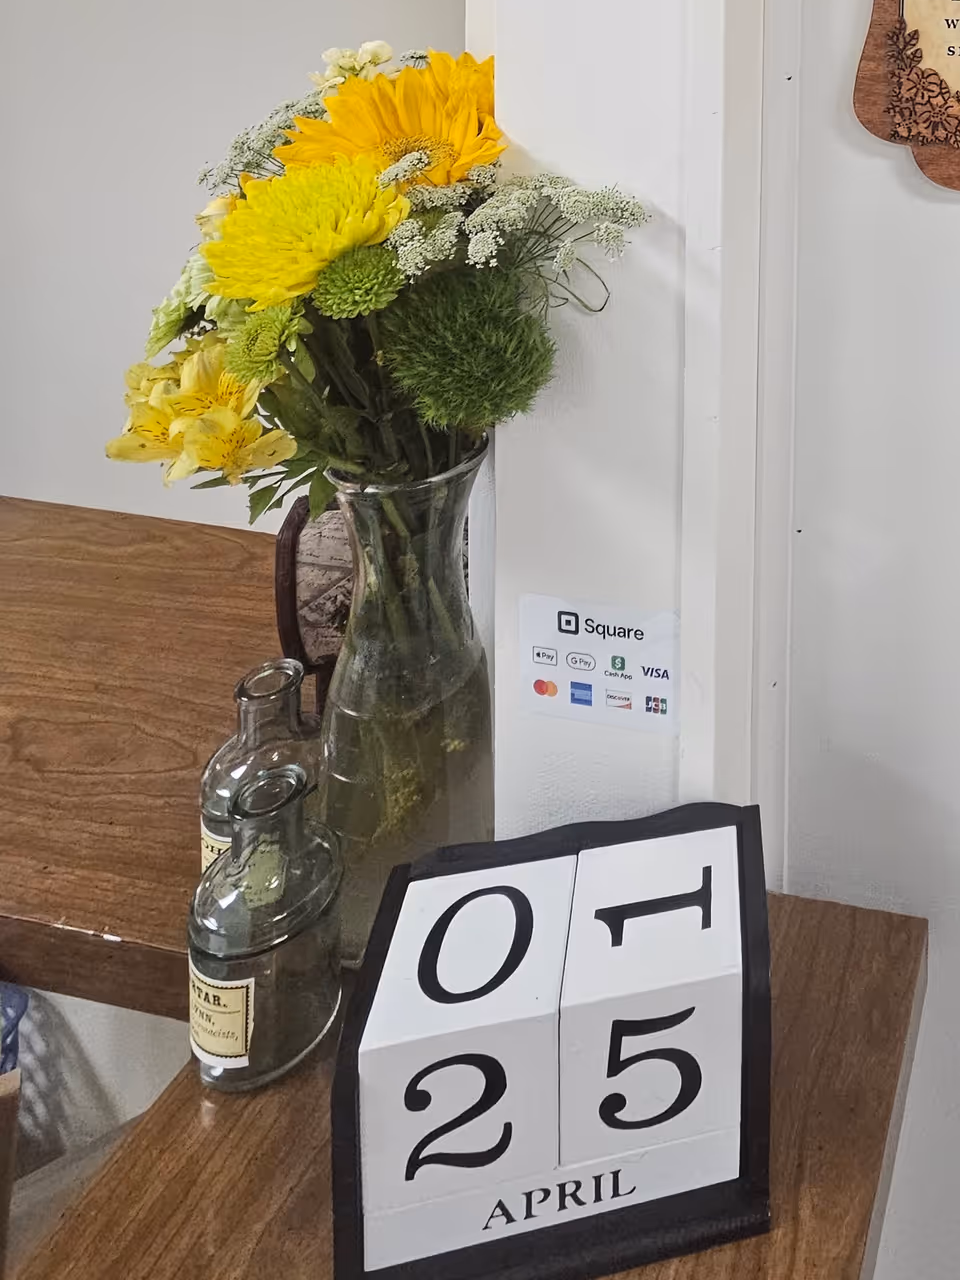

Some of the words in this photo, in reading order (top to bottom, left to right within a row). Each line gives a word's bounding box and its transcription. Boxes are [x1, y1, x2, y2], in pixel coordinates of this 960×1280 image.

[584, 618, 644, 641] Square
[541, 651, 555, 662] Pay
[578, 657, 592, 668] Pay
[604, 670, 618, 678] Cash
[619, 671, 633, 681] App
[640, 665, 670, 681] VISA
[481, 1168, 637, 1231] APRIL
